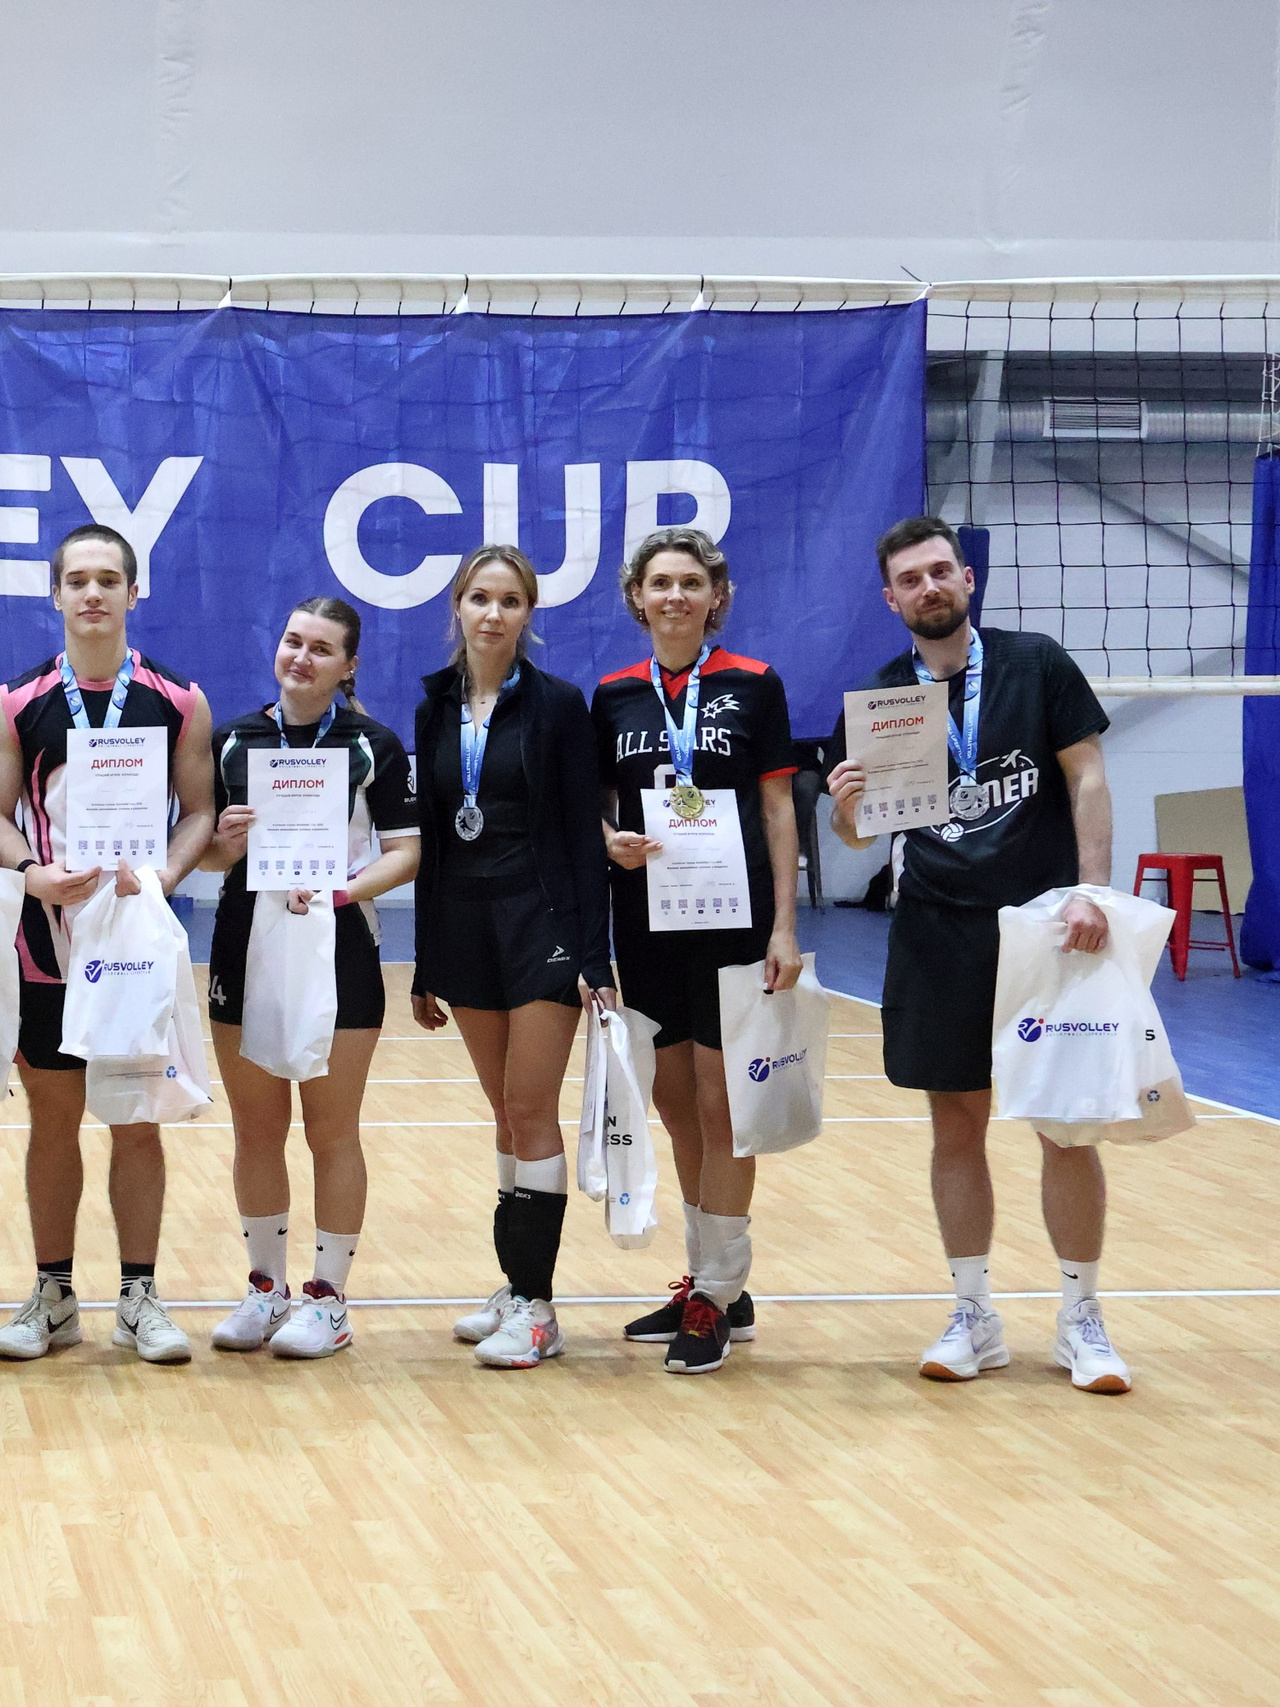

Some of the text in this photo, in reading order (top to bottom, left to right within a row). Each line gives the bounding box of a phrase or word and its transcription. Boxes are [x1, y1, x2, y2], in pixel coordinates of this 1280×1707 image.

[323, 459, 731, 610] CUP
[878, 695, 926, 707] RUSVOLLEY
[871, 716, 924, 732] ДИПЛОМ
[98, 737, 146, 745] RUSVOLLEY
[616, 731, 653, 763] ALL
[658, 727, 732, 756] SRS
[91, 758, 143, 769] ДИПЛОМ
[272, 779, 324, 790] ДИПЛОМ
[669, 818, 718, 829] ДИПЛОМ
[104, 961, 154, 971] RUSVOLLEY
[1046, 1022, 1120, 1033] RUSVOLLEY
